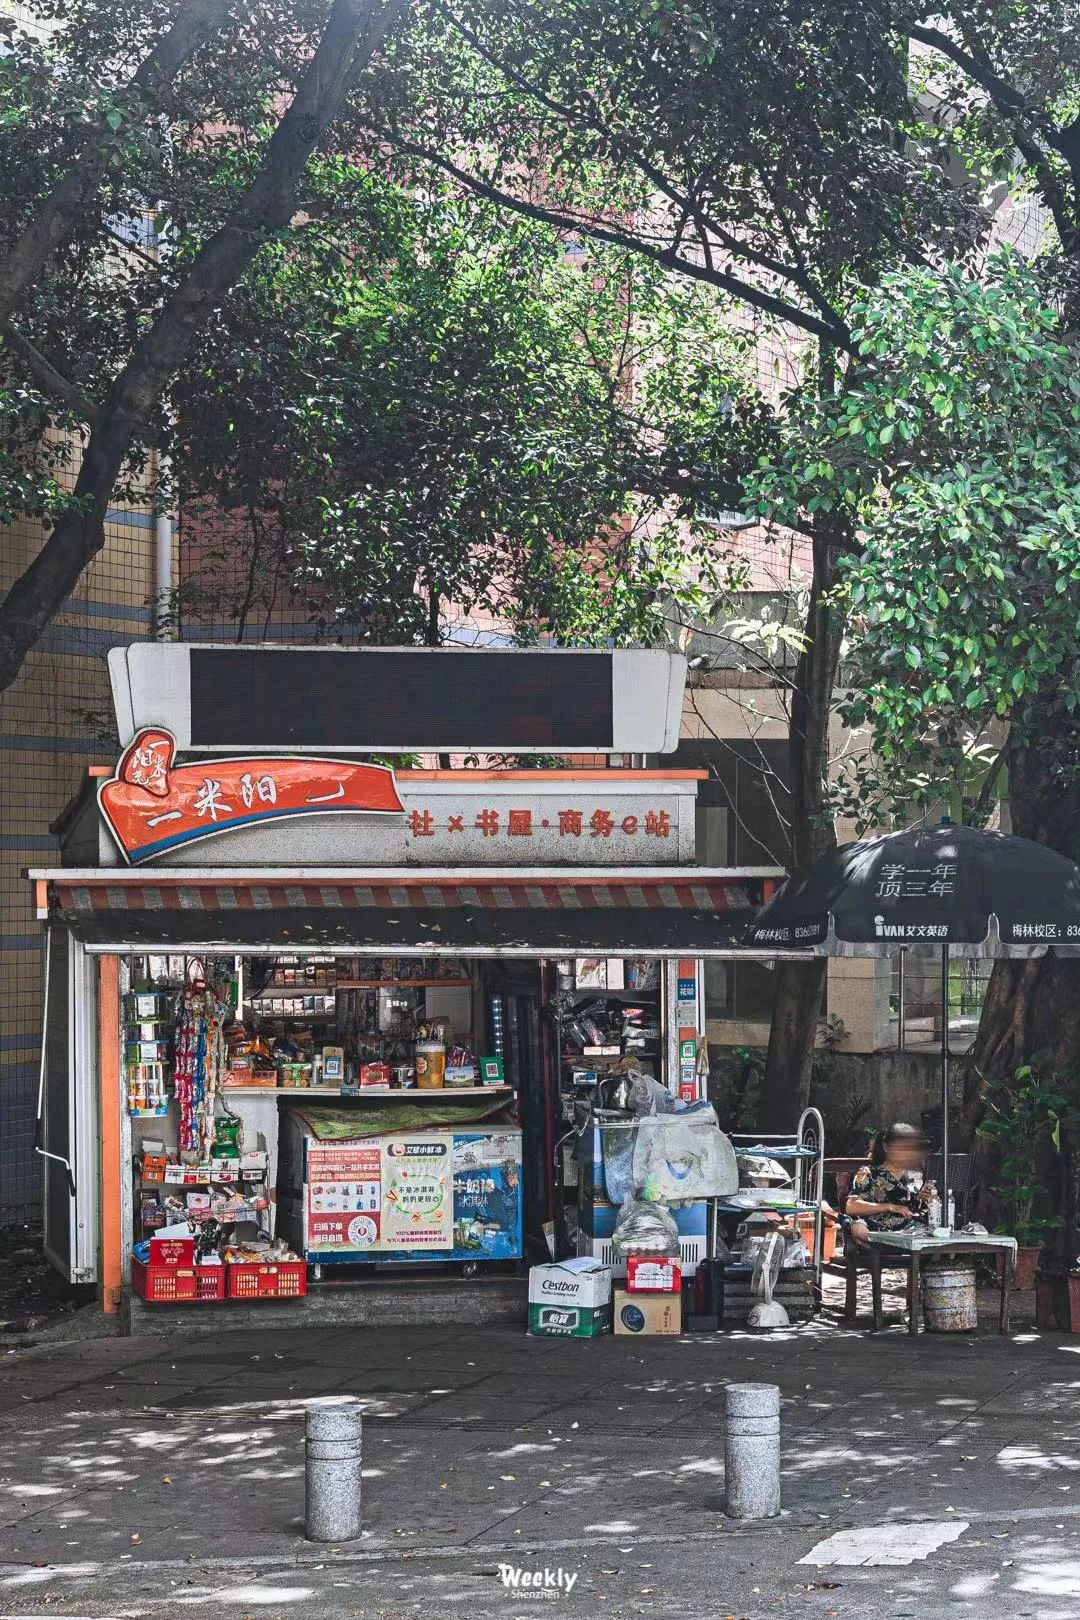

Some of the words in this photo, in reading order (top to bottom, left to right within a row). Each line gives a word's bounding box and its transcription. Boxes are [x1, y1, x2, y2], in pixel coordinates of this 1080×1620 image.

[146, 773, 345, 828] 一米阳
[880, 863, 957, 880] 学一年
[876, 880, 954, 898] 顶三年
[905, 925, 949, 937] 艾文英语
[1012, 923, 1062, 938] 梅林校区：
